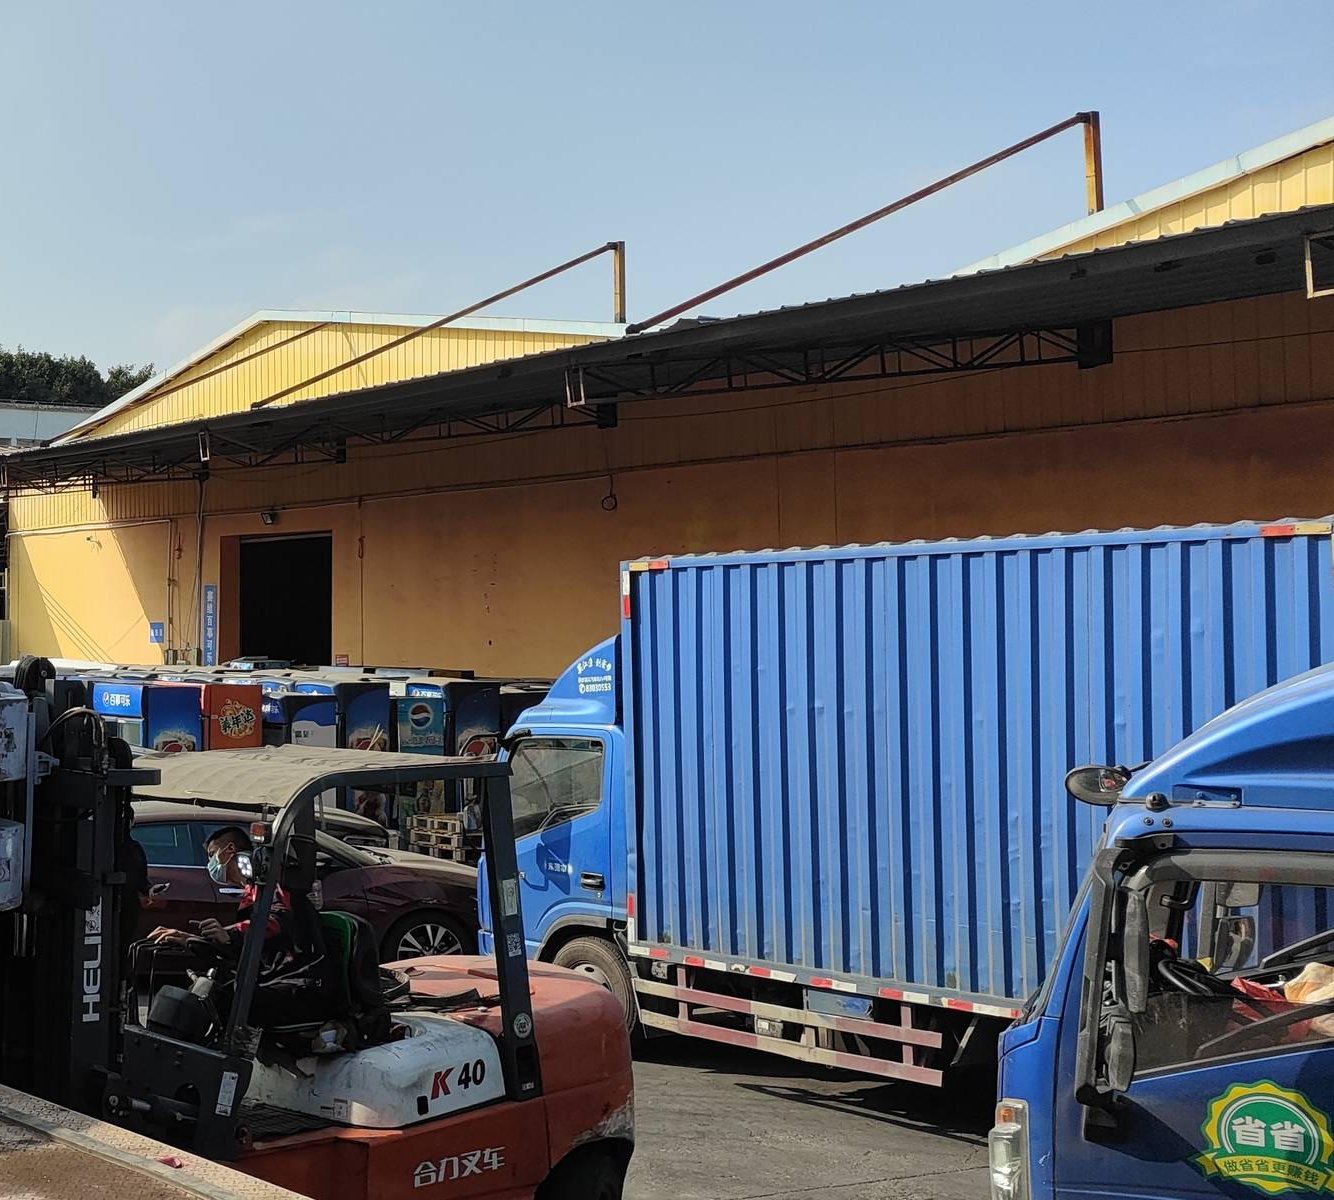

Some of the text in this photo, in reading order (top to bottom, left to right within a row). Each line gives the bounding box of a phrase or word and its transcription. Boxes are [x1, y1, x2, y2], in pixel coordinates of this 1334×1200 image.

[431, 1058, 486, 1100] K 40
[1232, 1116, 1306, 1152] 省省
[413, 1145, 507, 1188] 合力叉车
[1224, 1158, 1321, 1186] 做省省更赚钱
